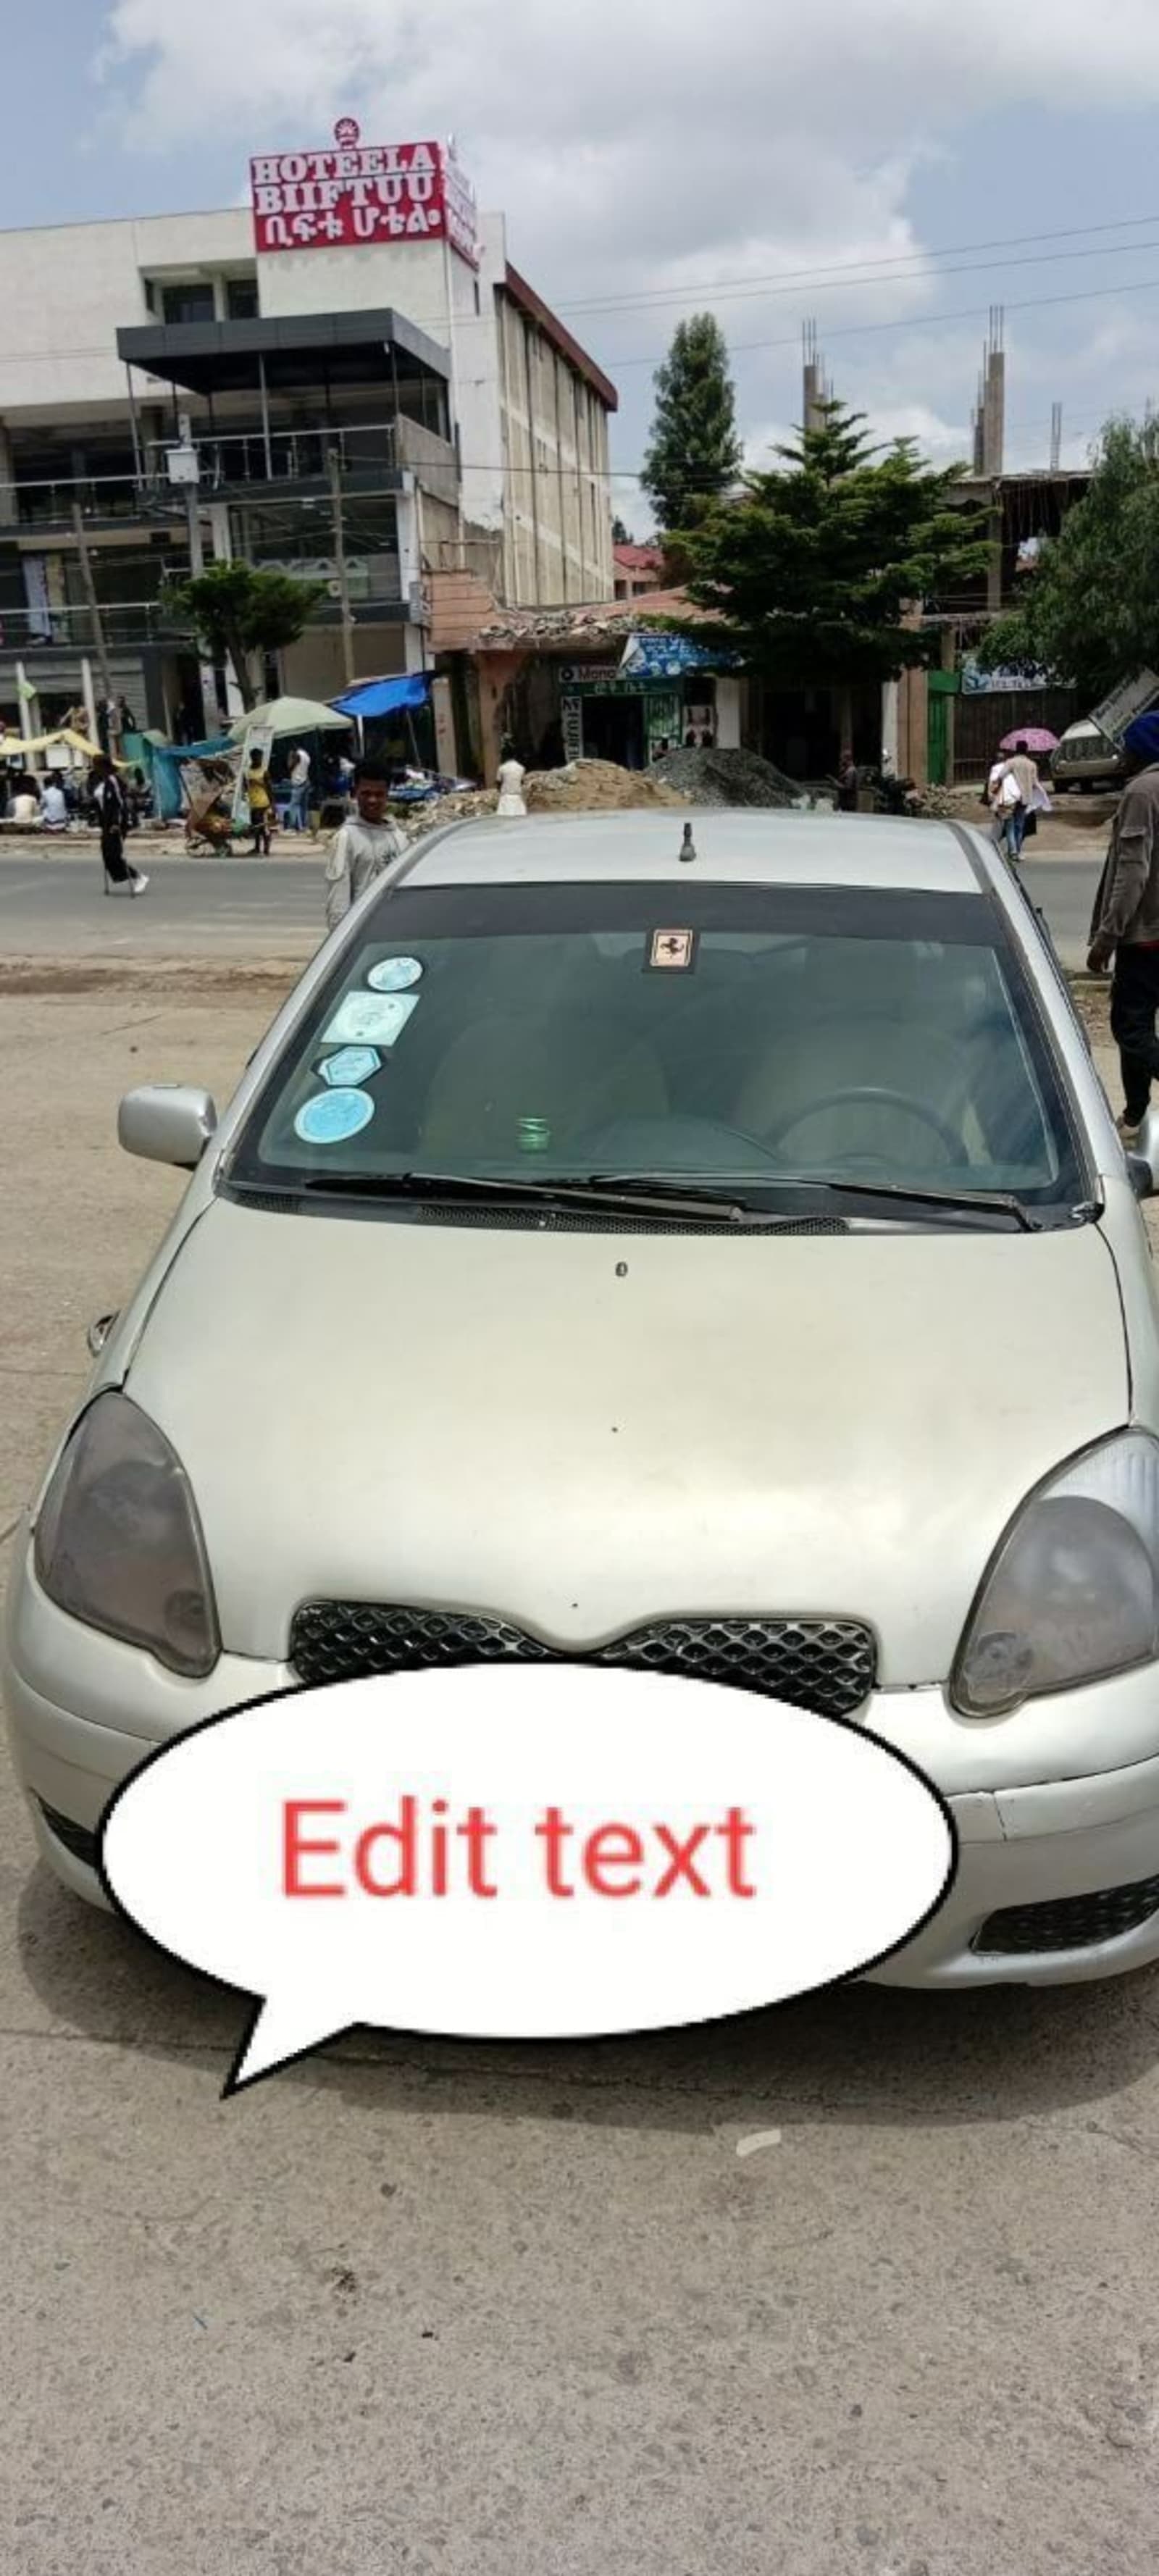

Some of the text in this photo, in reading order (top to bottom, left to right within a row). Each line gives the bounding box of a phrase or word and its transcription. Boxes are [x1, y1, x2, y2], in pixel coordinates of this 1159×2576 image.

[254, 145, 435, 183] HOTEELA
[255, 171, 434, 215] BIIFTUU
[353, 203, 440, 237] ሆቴል
